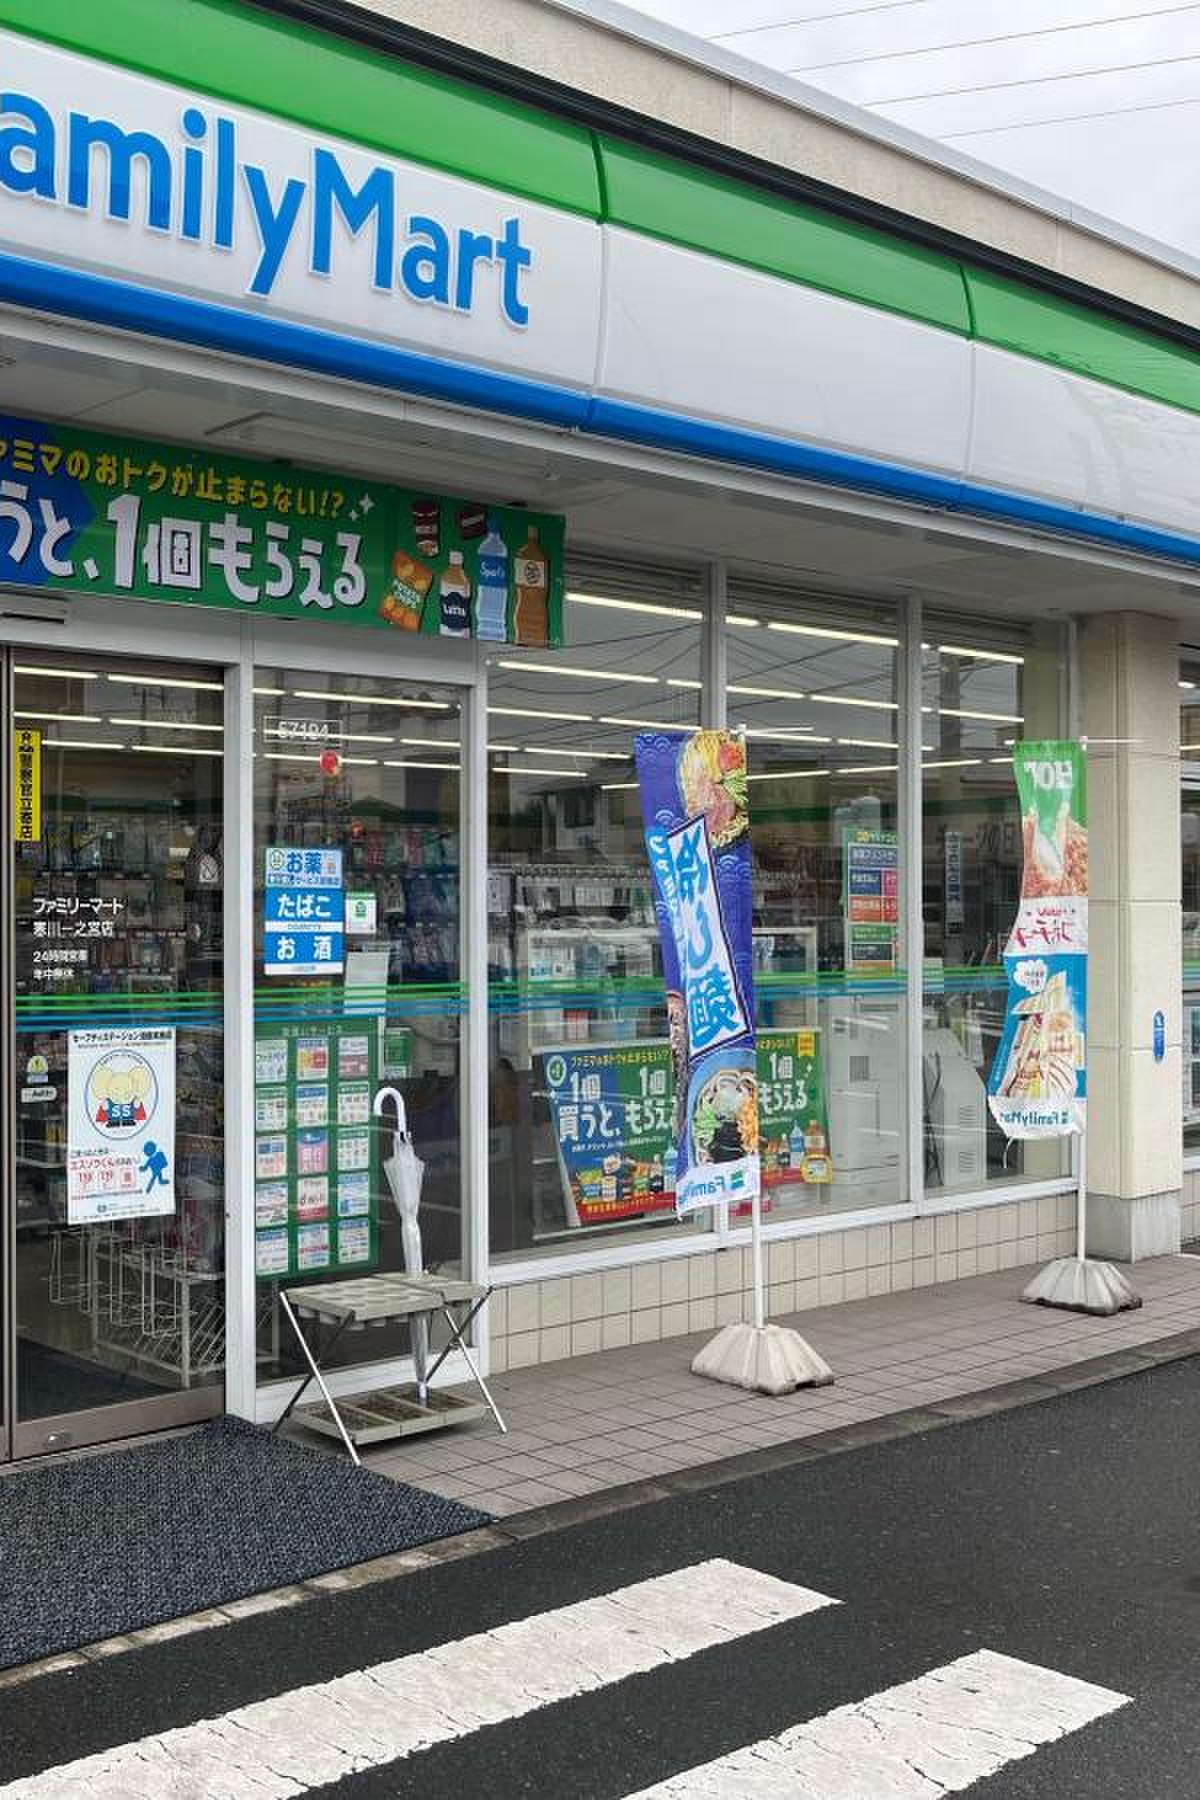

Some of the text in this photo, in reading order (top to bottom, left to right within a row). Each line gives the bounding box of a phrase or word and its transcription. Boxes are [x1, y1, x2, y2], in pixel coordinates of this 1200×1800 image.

[286, 851, 322, 874] お薬
[32, 897, 125, 915] ファミリーマート
[277, 893, 332, 918] たばこ
[276, 935, 332, 961] お酒
[757, 1079, 808, 1115] もらえる
[111, 1104, 132, 1118] SS
